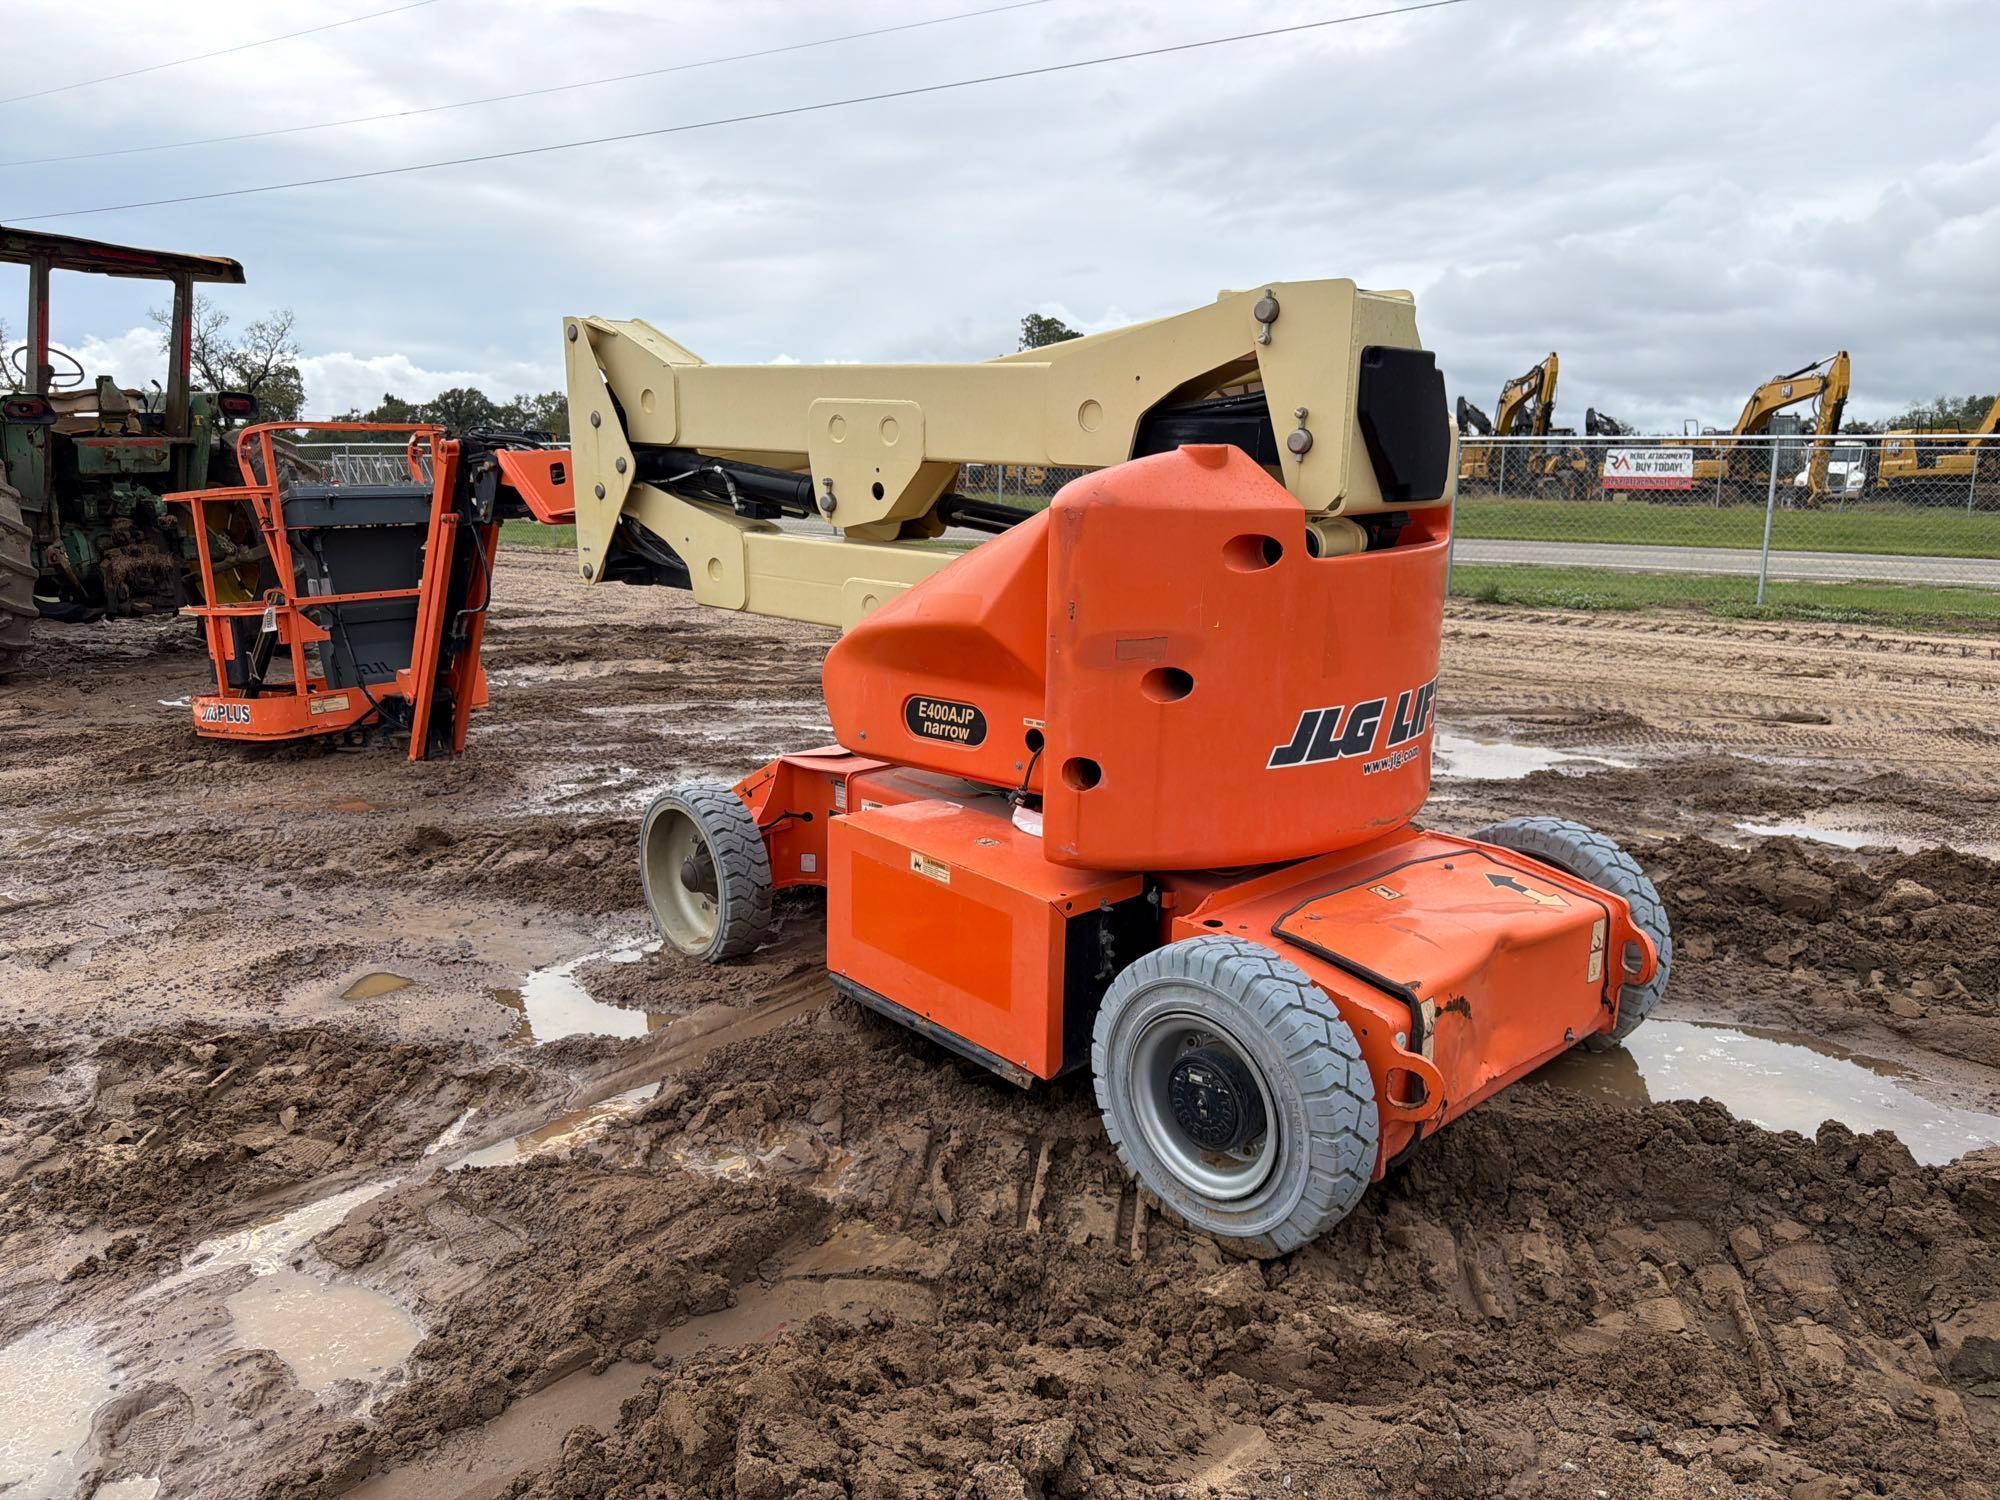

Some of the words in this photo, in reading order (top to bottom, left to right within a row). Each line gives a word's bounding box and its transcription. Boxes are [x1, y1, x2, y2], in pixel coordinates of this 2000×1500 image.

[1635, 462, 1651, 472] BUY
[1654, 462, 1683, 472] TODAY!
[1647, 452, 1692, 460] ATTACHMENTS
[918, 701, 975, 725] E400AJP
[923, 720, 970, 740] narrow
[1265, 697, 1388, 770] JLG
[1363, 745, 1420, 776] www.jlg.com
